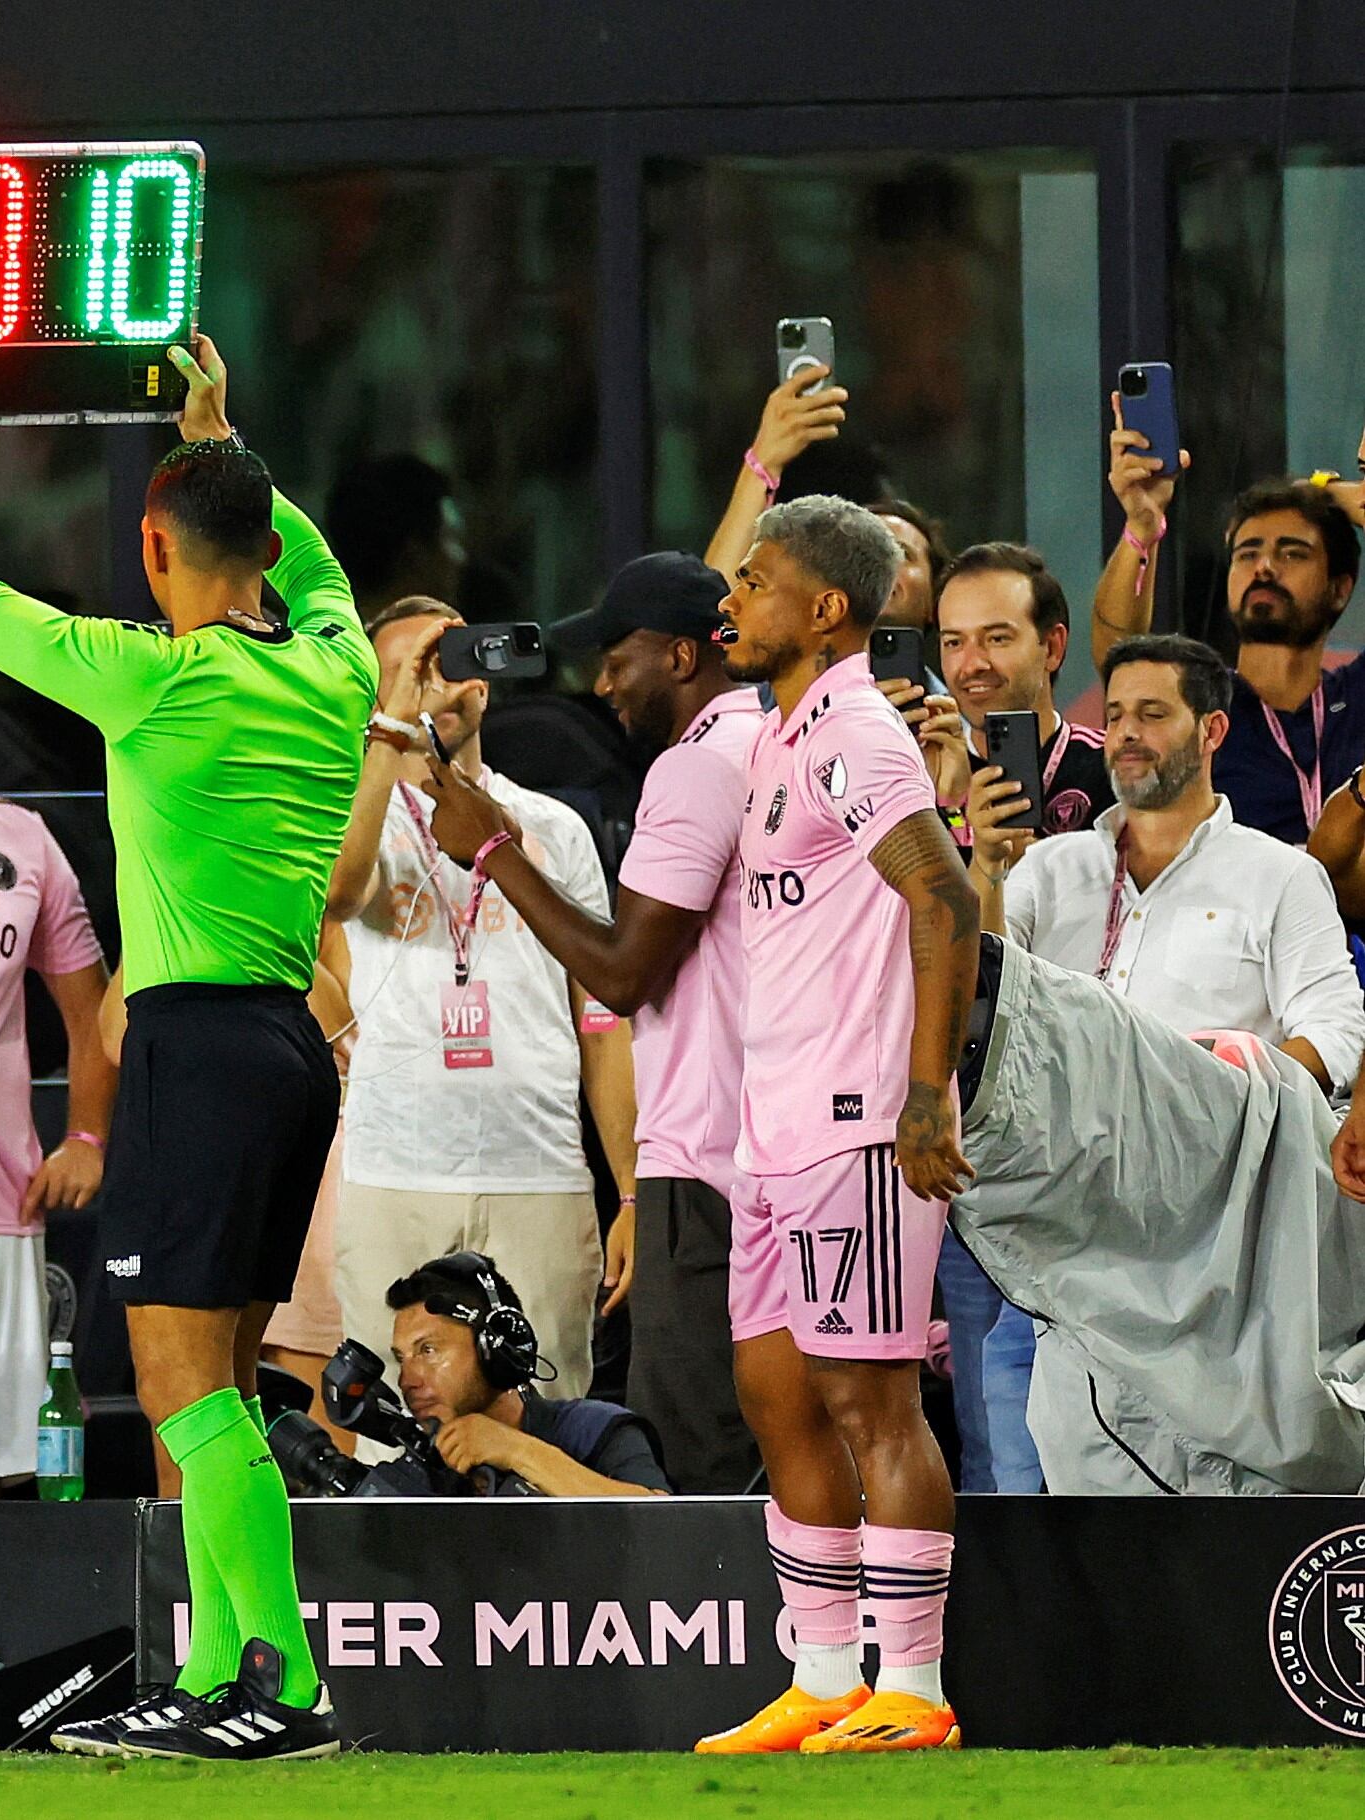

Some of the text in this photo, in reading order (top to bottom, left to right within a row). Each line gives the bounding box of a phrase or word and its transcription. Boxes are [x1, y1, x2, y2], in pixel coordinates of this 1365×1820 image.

[85, 159, 191, 339] 10
[445, 1006, 484, 1034] VIP
[789, 1227, 862, 1303] 17
[815, 1325, 854, 1335] adidas
[173, 1601, 444, 1667] IER
[474, 1600, 746, 1666] MIAMI
[1279, 1629, 1308, 1686] CLUB
[17, 1663, 94, 1730] SHURE
